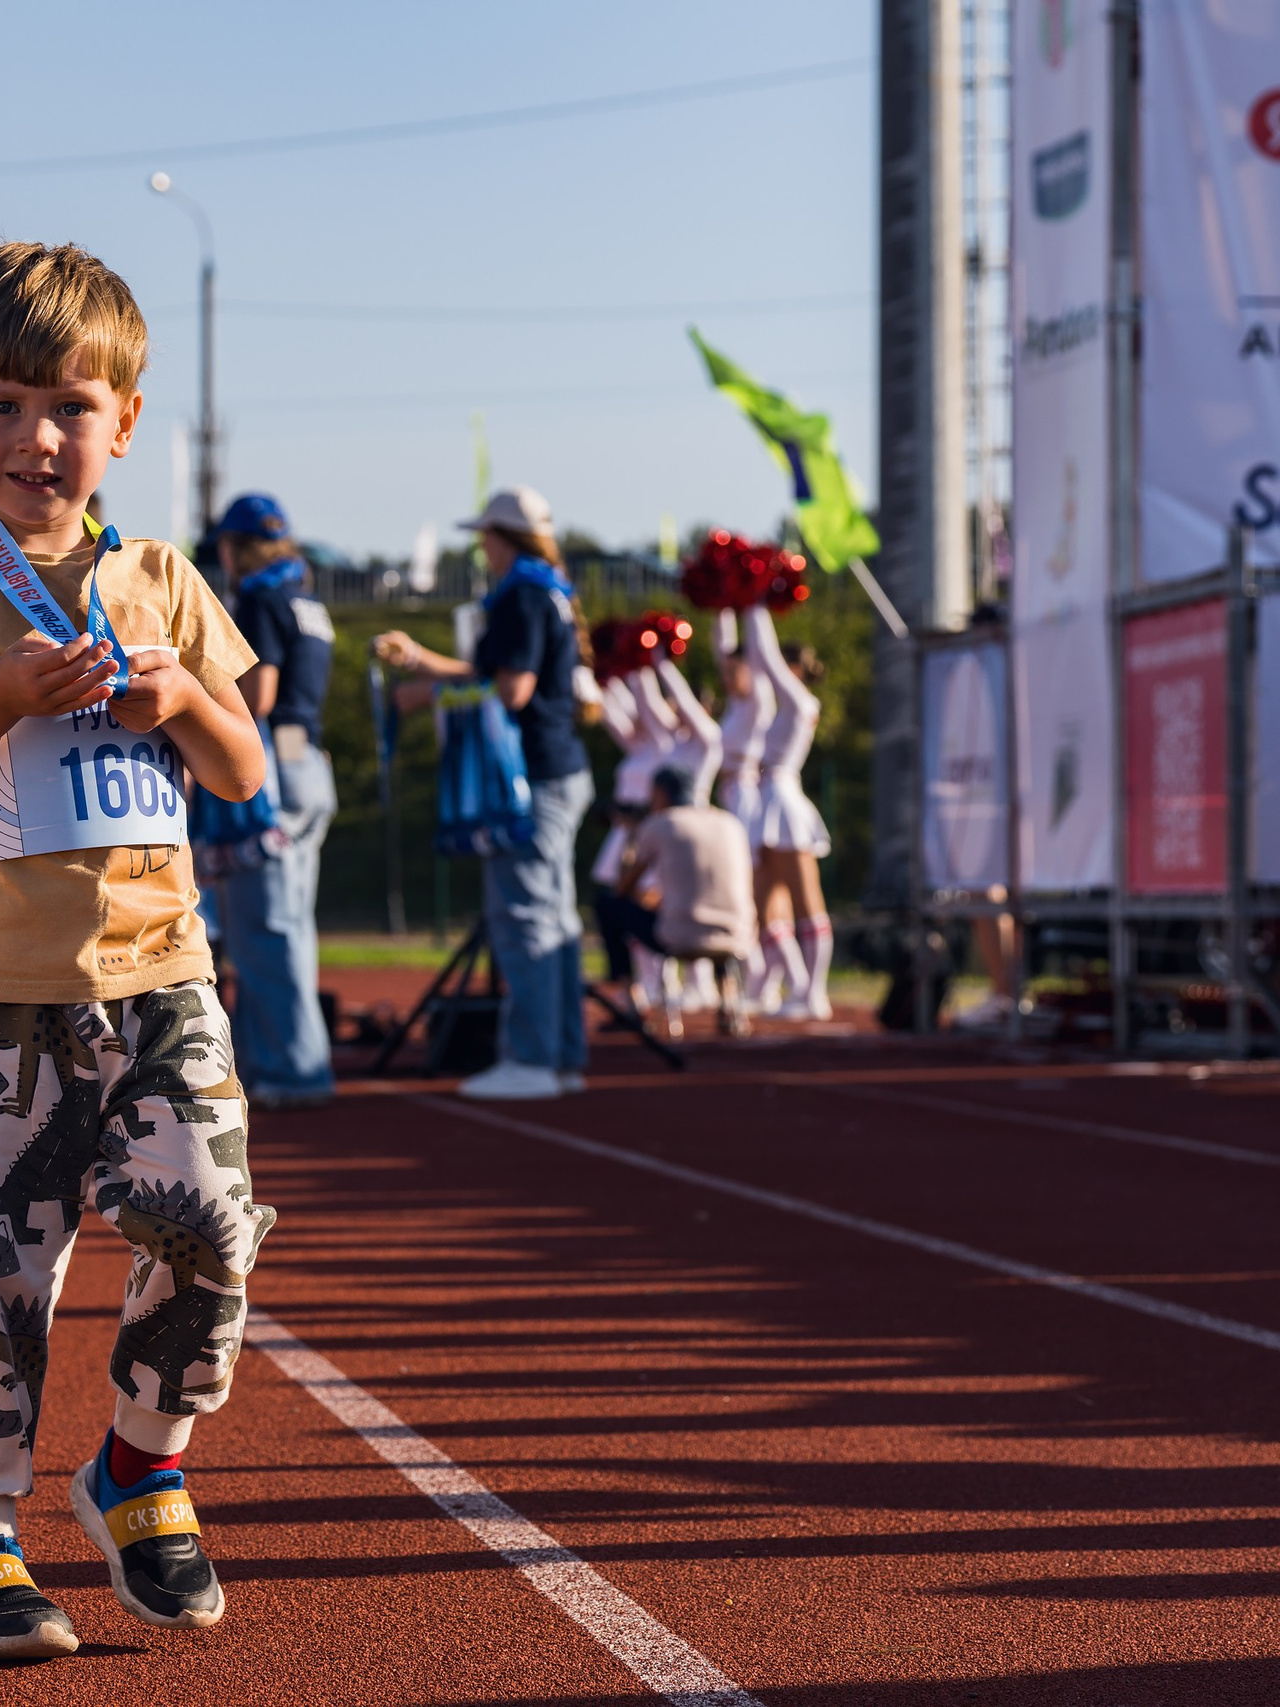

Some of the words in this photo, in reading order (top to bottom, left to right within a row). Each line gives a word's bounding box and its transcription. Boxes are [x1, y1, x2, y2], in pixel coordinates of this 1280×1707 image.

[18, 587, 43, 604] 29
[27, 602, 72, 639] ПЕРВЫМ
[72, 698, 126, 732] РУС
[60, 742, 177, 821] 1663
